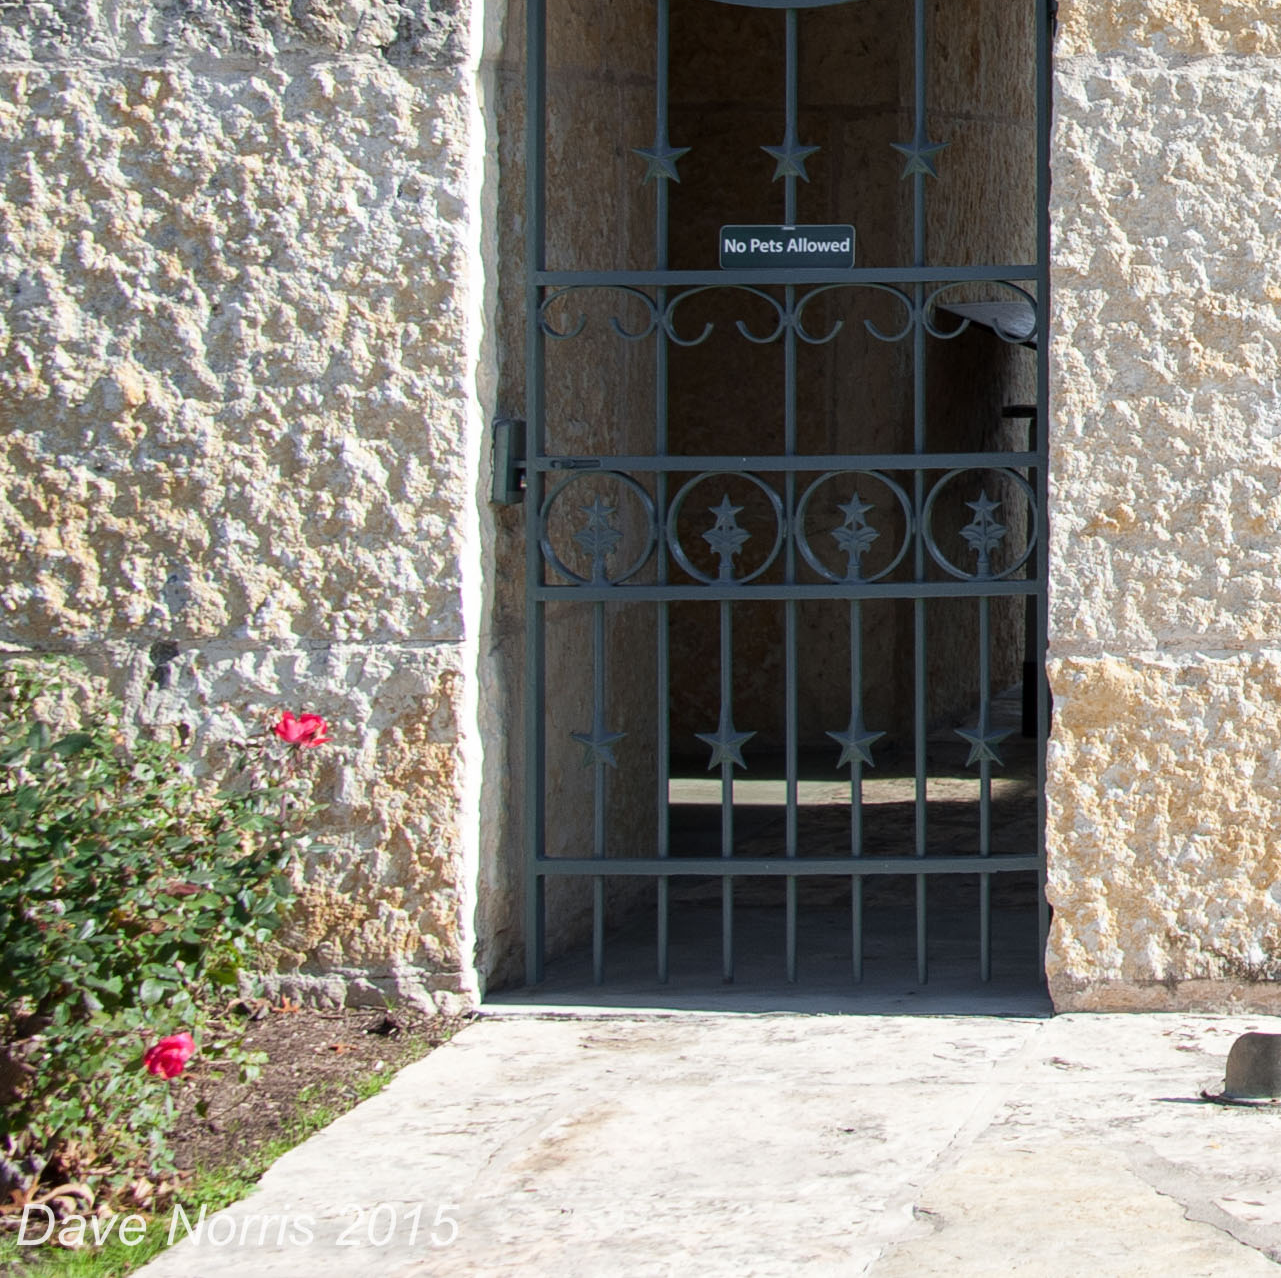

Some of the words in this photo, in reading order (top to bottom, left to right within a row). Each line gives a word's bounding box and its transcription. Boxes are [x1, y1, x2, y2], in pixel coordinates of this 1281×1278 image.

[724, 239, 746, 253] No
[750, 238, 783, 253] Pets
[787, 237, 850, 253] Allowed
